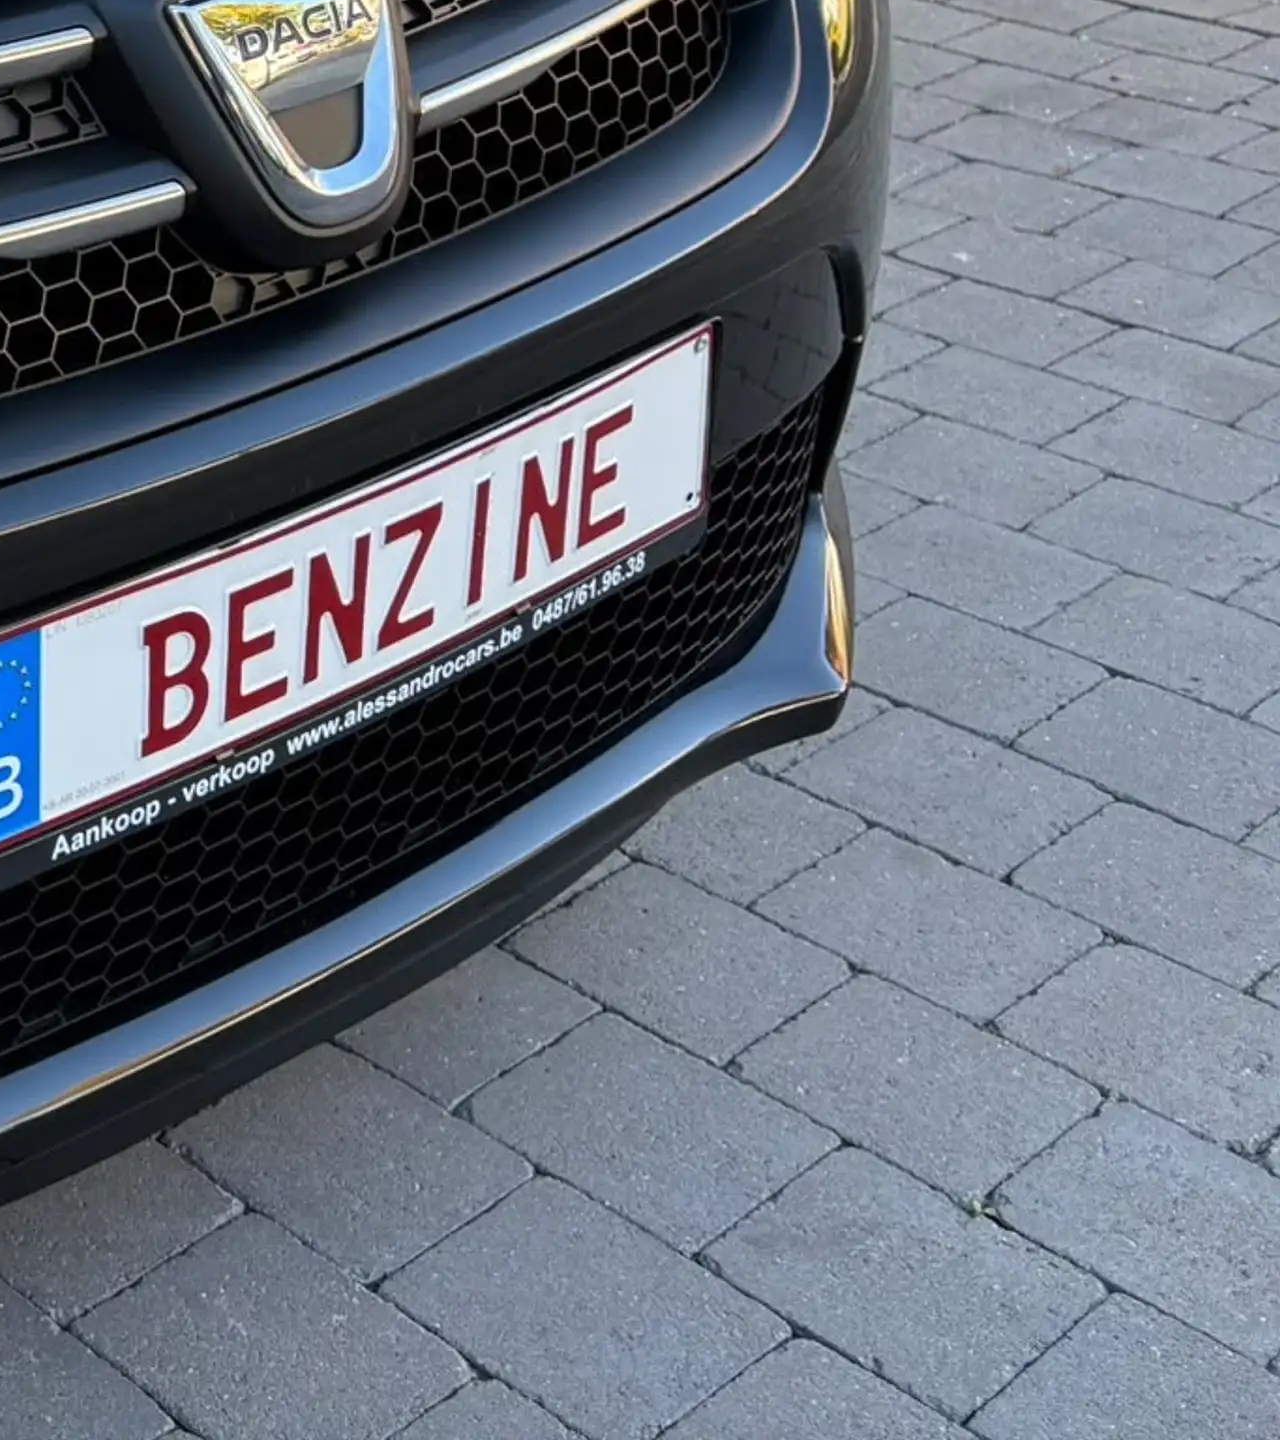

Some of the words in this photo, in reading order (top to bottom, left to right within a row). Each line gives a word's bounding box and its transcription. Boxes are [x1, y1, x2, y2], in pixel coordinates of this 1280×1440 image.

[50, 797, 162, 861] Aankoop
[181, 747, 276, 803] verkoop
[286, 622, 524, 756] www.alessandrocars.be
[531, 551, 646, 631] 0487/61.96.38
[140, 403, 636, 759] BENZINE
